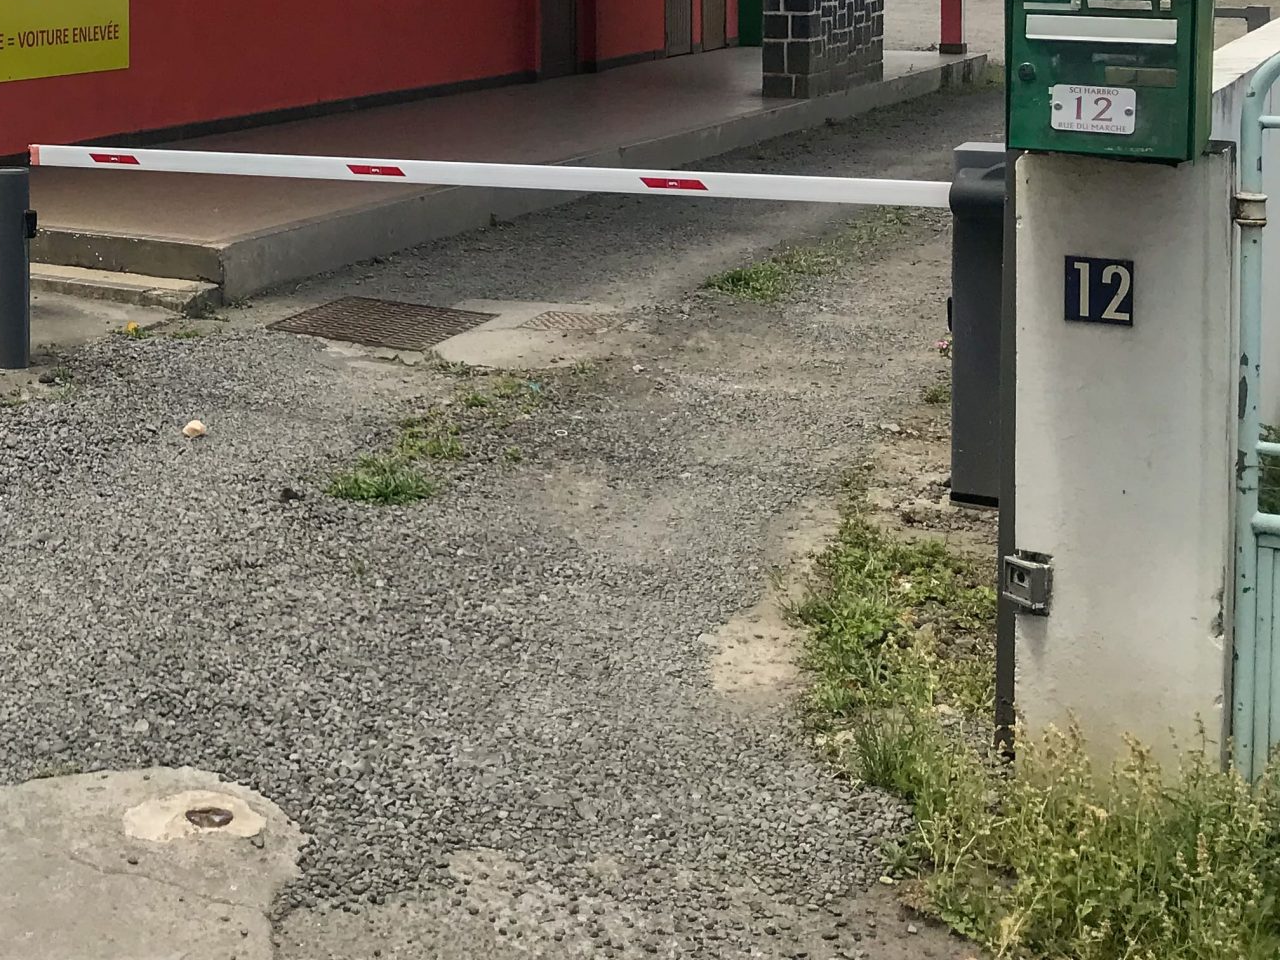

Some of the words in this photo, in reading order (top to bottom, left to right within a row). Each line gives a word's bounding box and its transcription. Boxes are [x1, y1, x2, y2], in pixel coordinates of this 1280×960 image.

[18, 29, 69, 49] VOITURE
[72, 21, 119, 43] ENLEVÉE
[1069, 86, 1082, 94] SCI
[1084, 87, 1119, 96] HARBRO
[1075, 95, 1113, 122] 12
[1073, 262, 1131, 321] 12
